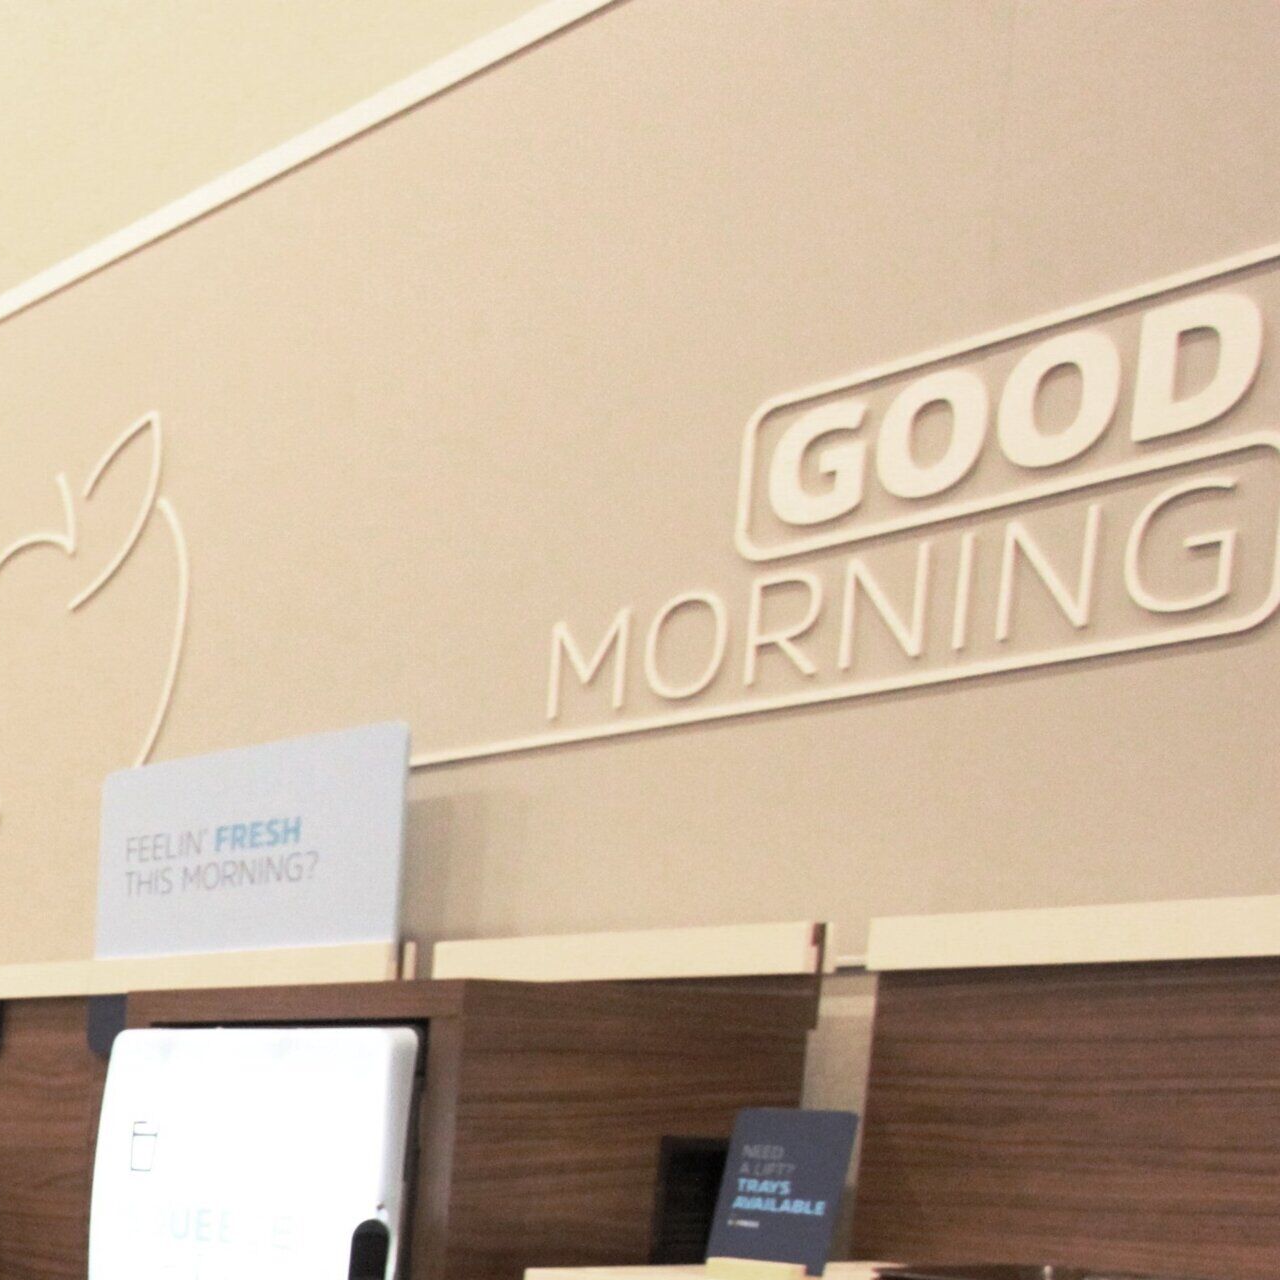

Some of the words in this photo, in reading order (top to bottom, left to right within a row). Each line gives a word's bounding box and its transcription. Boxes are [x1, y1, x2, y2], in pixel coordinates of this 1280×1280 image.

[769, 293, 1262, 525] GOOD
[547, 476, 1237, 718] MORNING
[214, 816, 302, 853] FRESH
[126, 866, 173, 896] THIS
[183, 851, 320, 892] MORNING?
[732, 1195, 826, 1217] AVAILABLE
[737, 1178, 791, 1195] TRAYS
